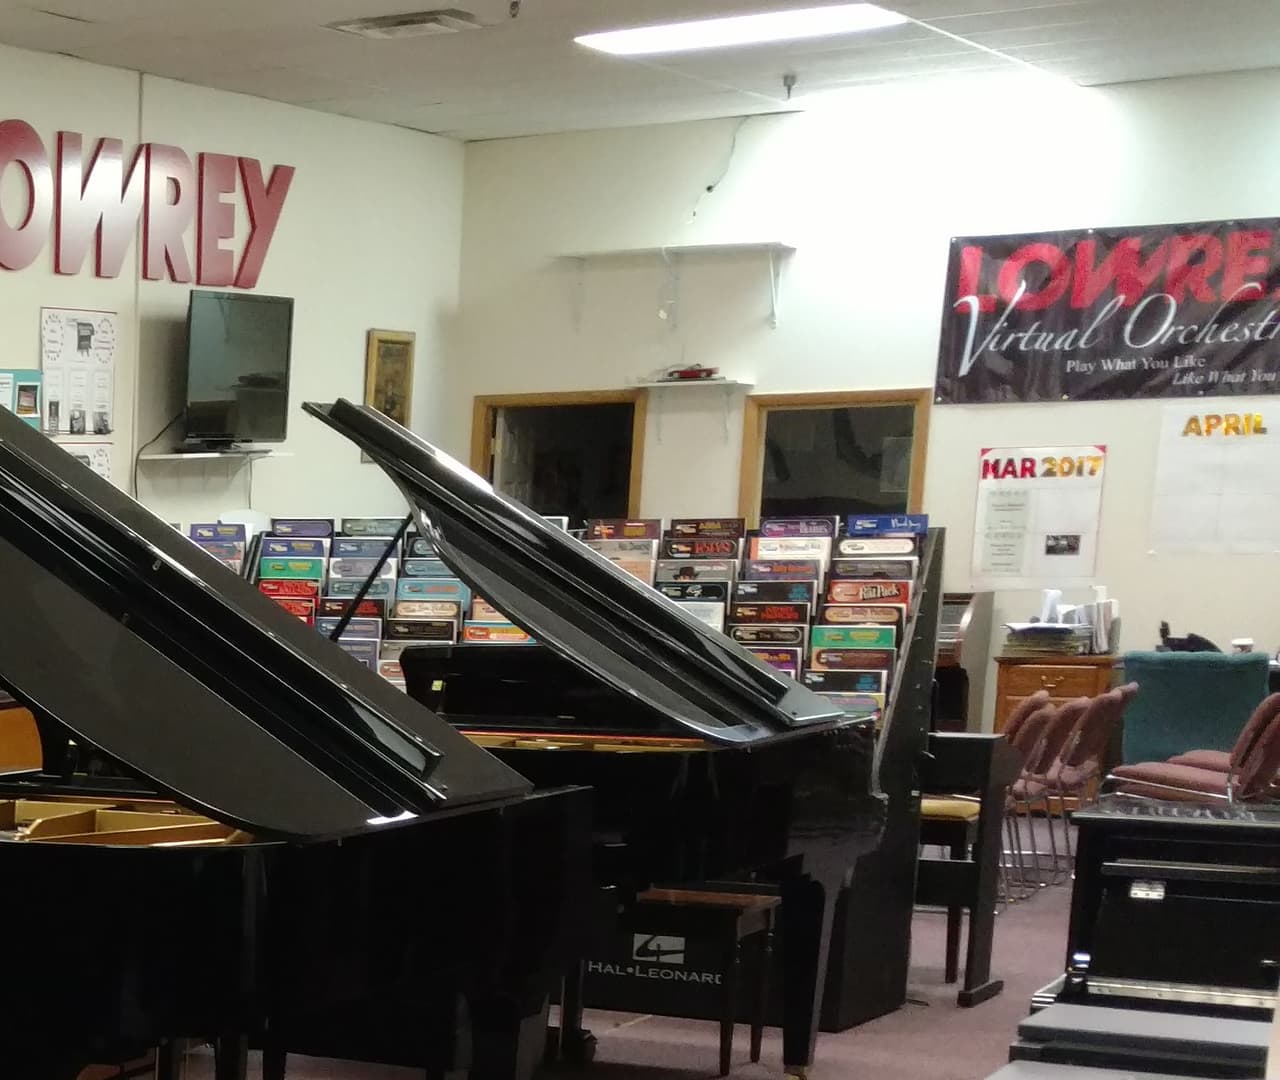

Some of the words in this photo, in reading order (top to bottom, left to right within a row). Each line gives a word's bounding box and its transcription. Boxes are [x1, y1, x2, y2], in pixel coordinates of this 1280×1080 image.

[955, 230, 1280, 314] LOWRE
[953, 279, 1126, 378] Virtual
[1066, 359, 1096, 374] Play
[1101, 358, 1137, 371] What
[1142, 356, 1169, 370] You
[1173, 354, 1206, 369] Like
[1172, 372, 1206, 386] Like
[1208, 370, 1247, 384] What
[1250, 369, 1277, 382] You
[1181, 412, 1268, 437] APRIL
[981, 457, 1037, 480] MAR
[1040, 455, 1104, 477] 2017
